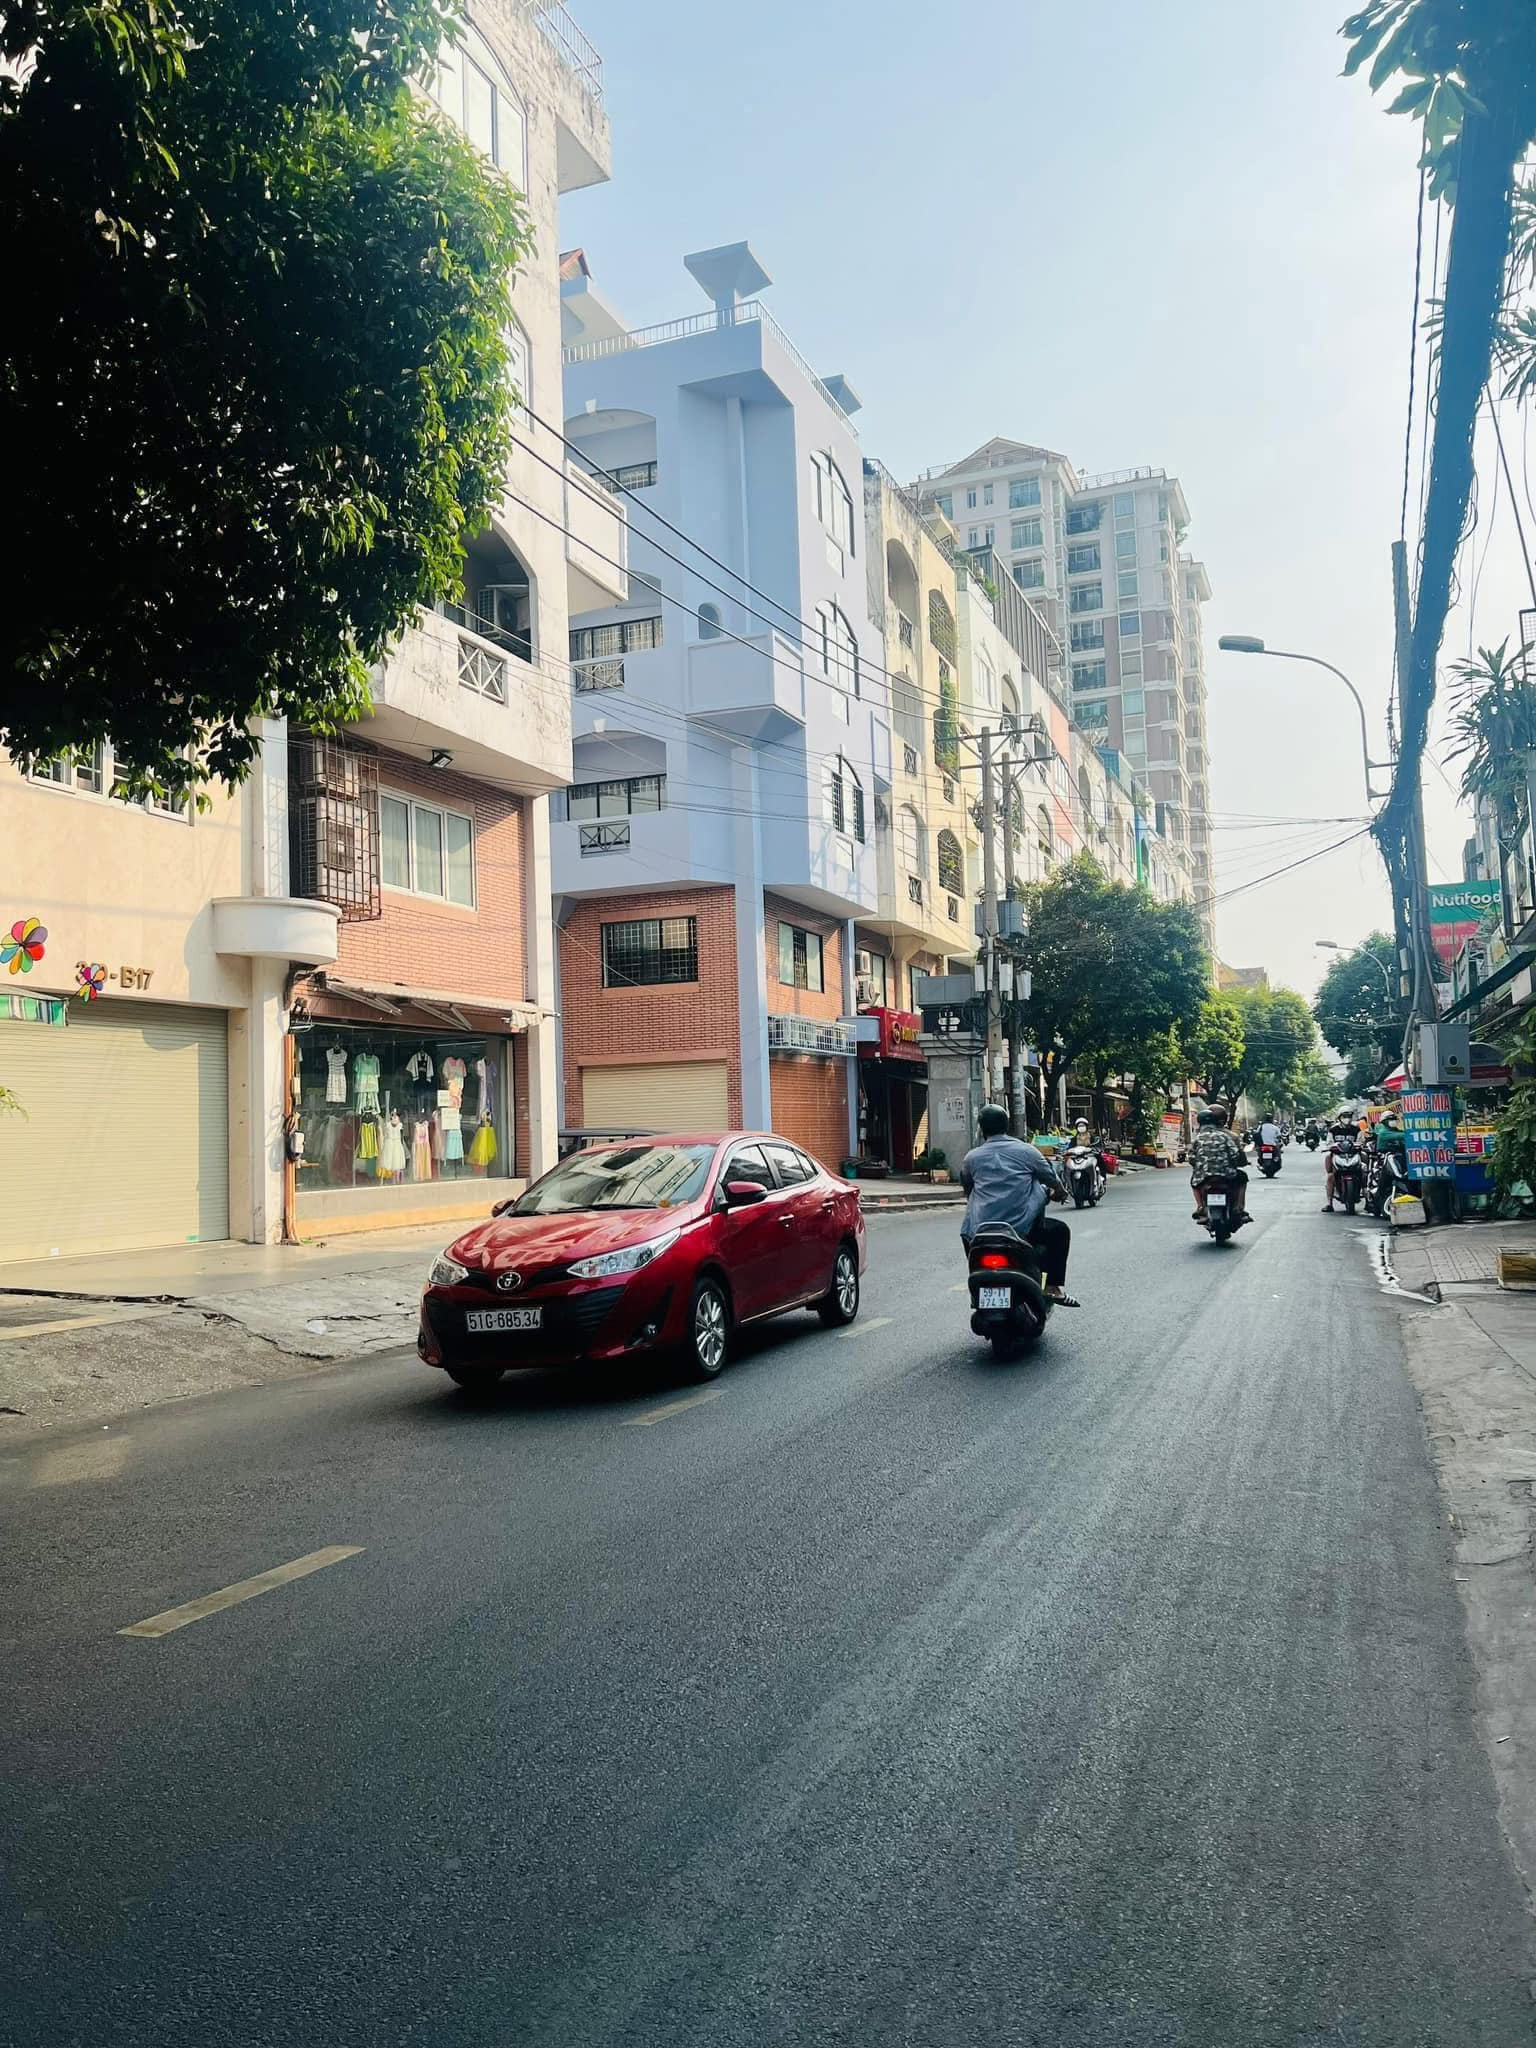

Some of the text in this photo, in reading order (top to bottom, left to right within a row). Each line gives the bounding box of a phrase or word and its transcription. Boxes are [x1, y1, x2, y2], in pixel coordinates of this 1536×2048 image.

[1432, 890, 1502, 908] Nutifood
[1410, 1131, 1448, 1142] 10K
[1408, 1145, 1430, 1164] TRÀ
[1413, 1165, 1449, 1177] 10K
[468, 1311, 539, 1330] 51G-685.34
